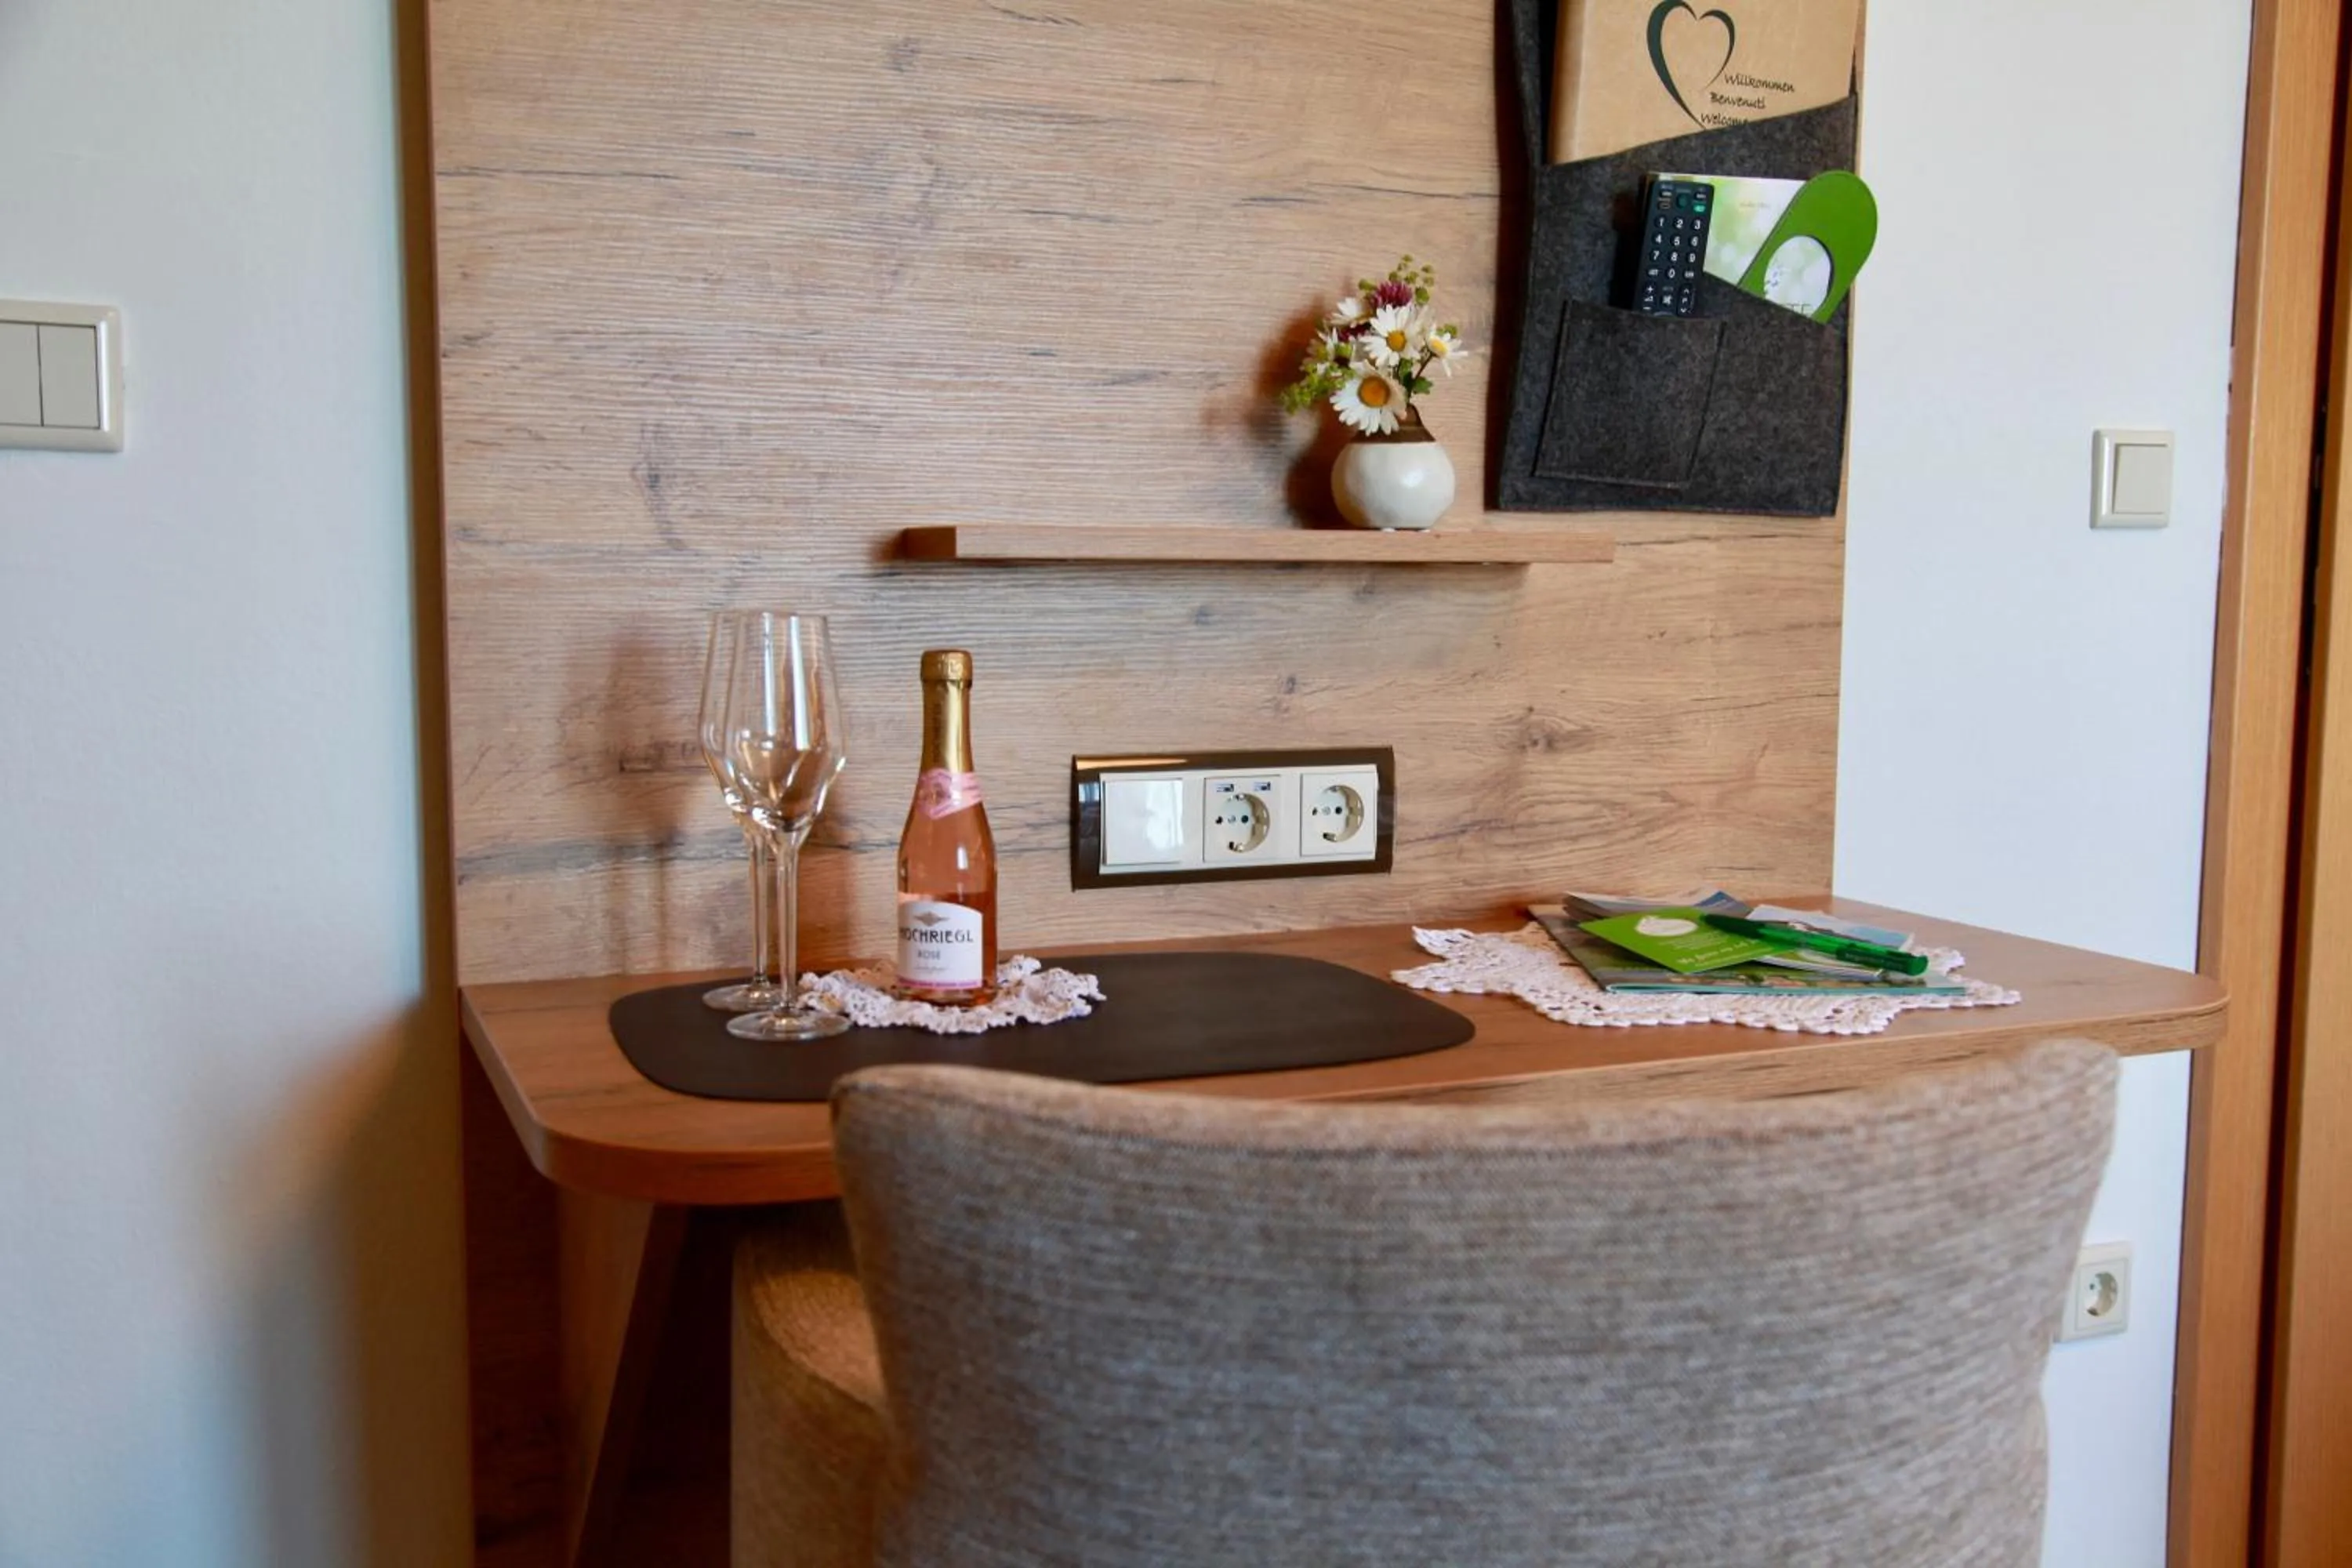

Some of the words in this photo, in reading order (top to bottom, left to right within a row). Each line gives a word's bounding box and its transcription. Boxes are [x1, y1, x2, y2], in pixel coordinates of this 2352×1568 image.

[1724, 72, 1795, 93] Willkommen
[1709, 91, 1766, 110] Benvenuti
[1659, 217, 1664, 227] 1
[1676, 219, 1683, 228] 2
[1694, 220, 1700, 230] 3
[1655, 234, 1662, 244] 4
[1674, 236, 1680, 245] 5
[1691, 236, 1698, 246] 6
[1653, 250, 1660, 260] 7
[1671, 252, 1678, 261] 8
[1689, 252, 1696, 263] 9
[1668, 268, 1675, 278] 0
